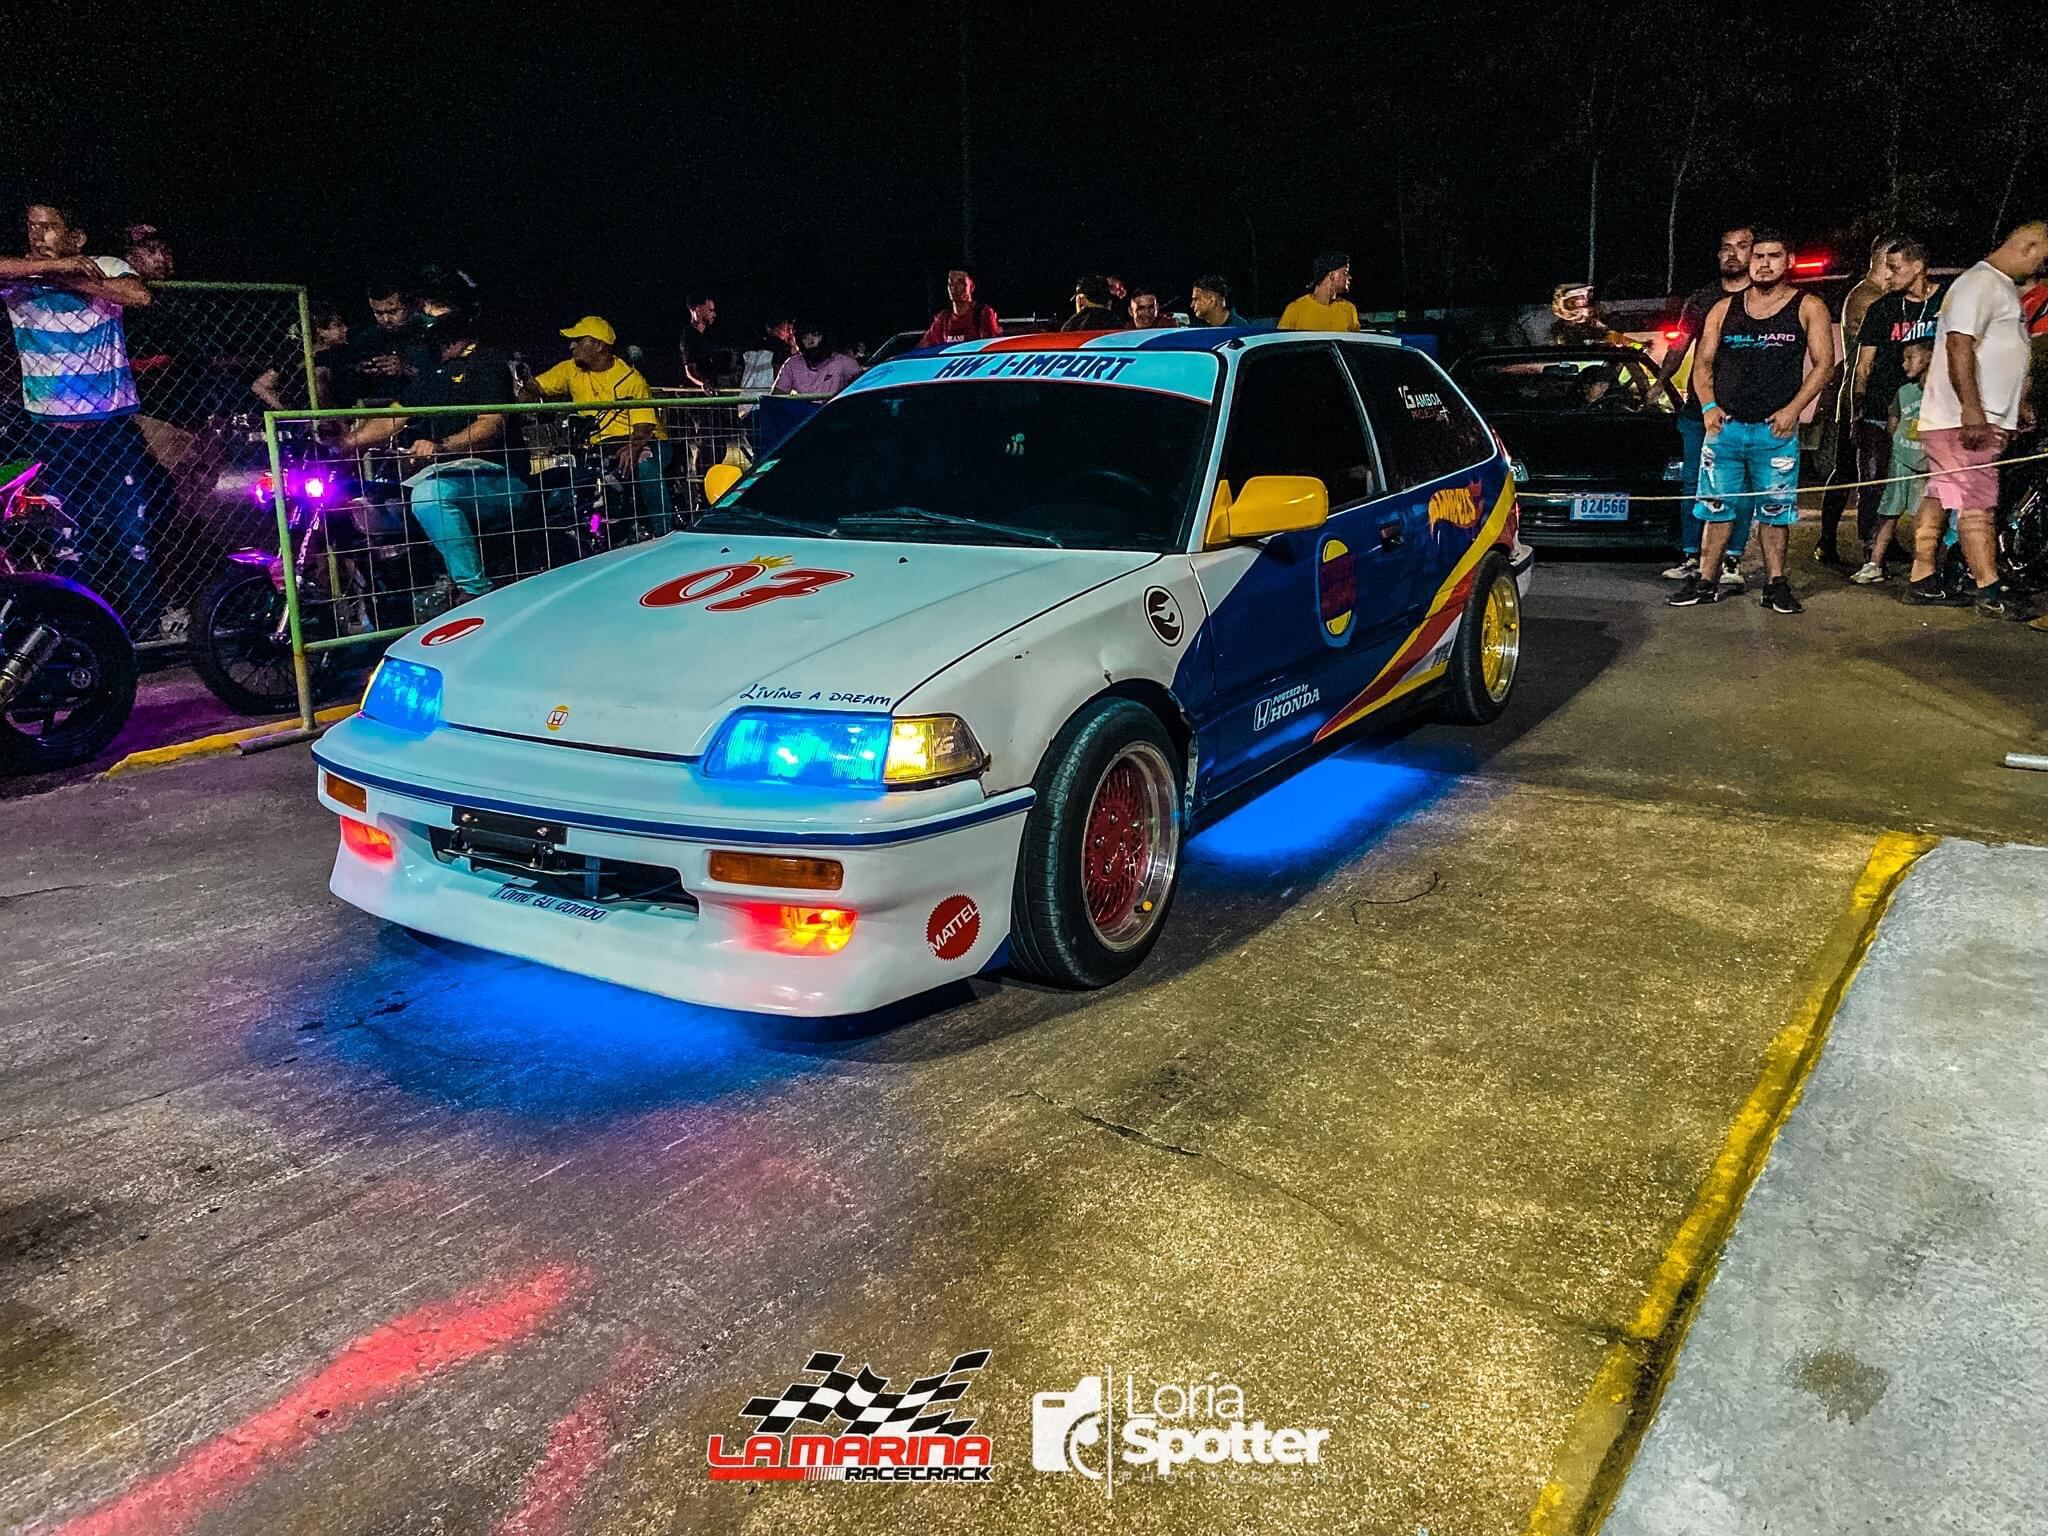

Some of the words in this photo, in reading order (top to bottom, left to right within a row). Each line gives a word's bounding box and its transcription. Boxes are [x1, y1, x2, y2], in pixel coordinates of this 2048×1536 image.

[1758, 333, 1796, 342] HARD
[1889, 320, 1936, 341] ADIDA
[934, 356, 991, 380] HW
[989, 354, 1137, 380] J-IMPORT
[1580, 499, 1627, 514] 824566
[638, 562, 856, 614] 07
[808, 691, 821, 700] A
[1270, 688, 1321, 723] HONDA
[555, 901, 607, 920] combo
[928, 903, 979, 956] MATTEL
